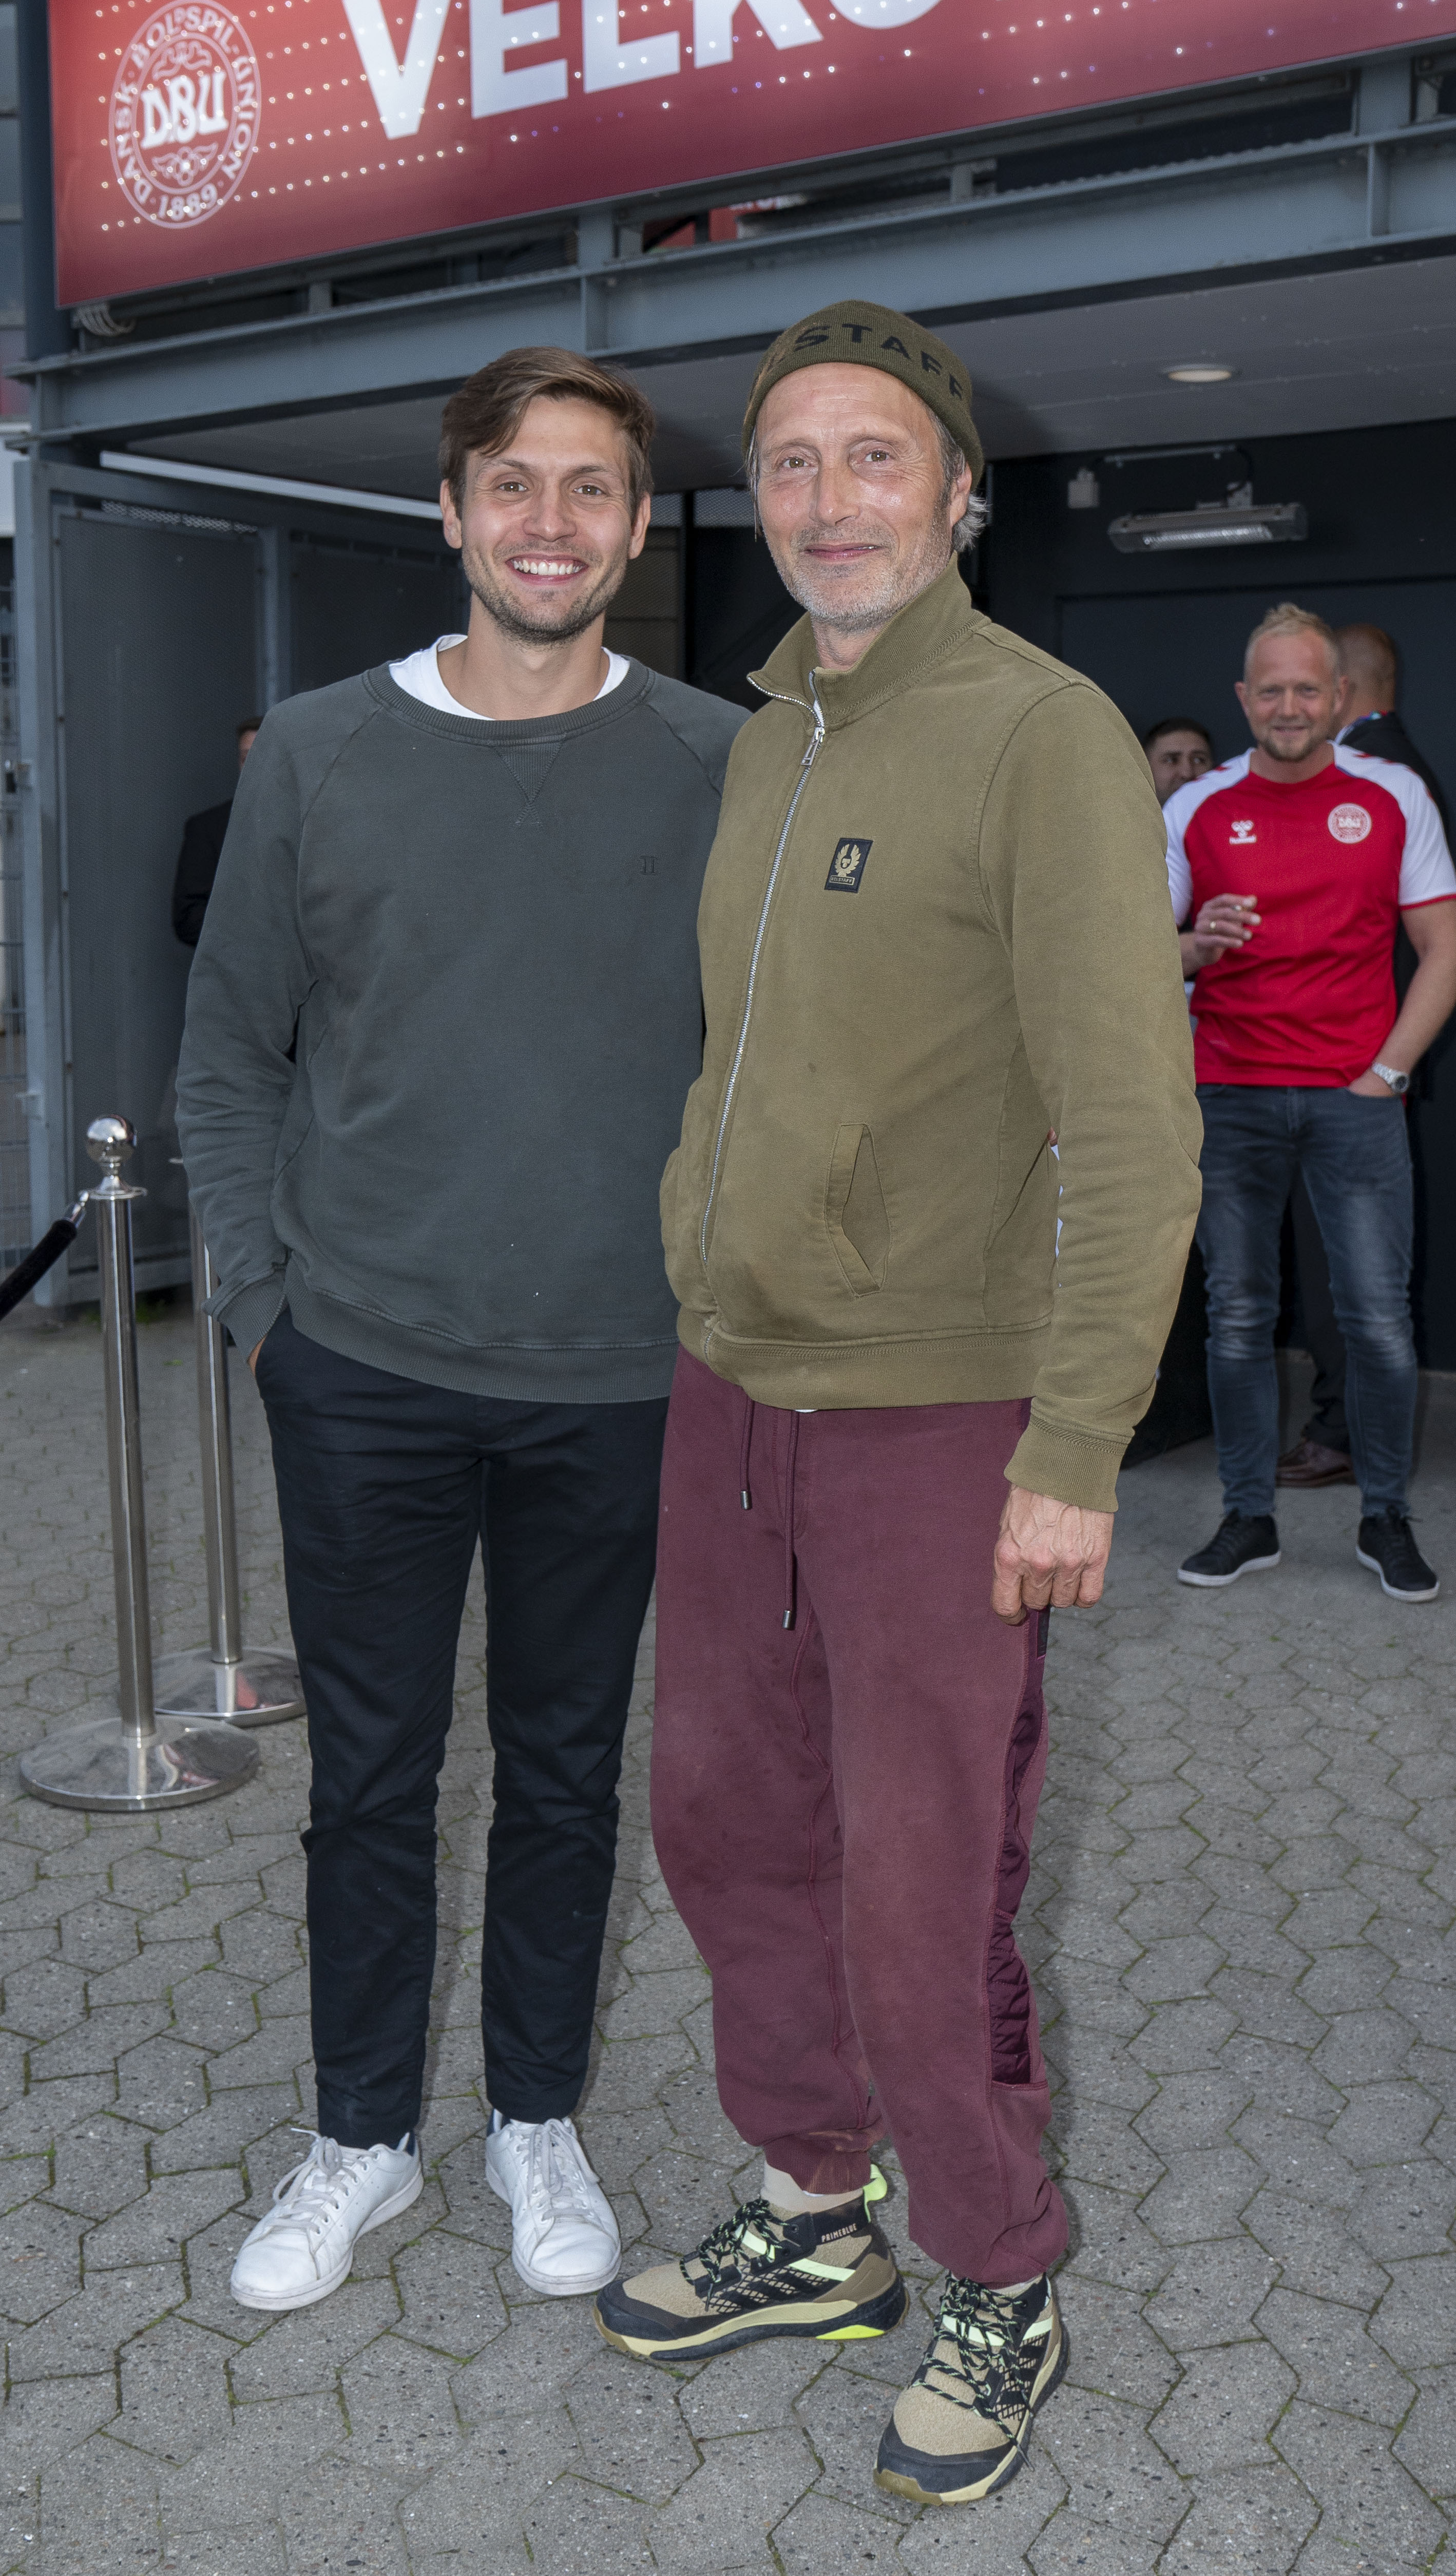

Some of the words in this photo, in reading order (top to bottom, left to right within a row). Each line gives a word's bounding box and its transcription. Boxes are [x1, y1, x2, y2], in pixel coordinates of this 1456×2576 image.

[341, 0, 942, 140] VEL
[140, 70, 229, 149] DBU
[158, 183, 218, 221] 1889
[794, 323, 964, 400] STAFF
[821, 2222, 857, 2243] PRIMEBLUE
